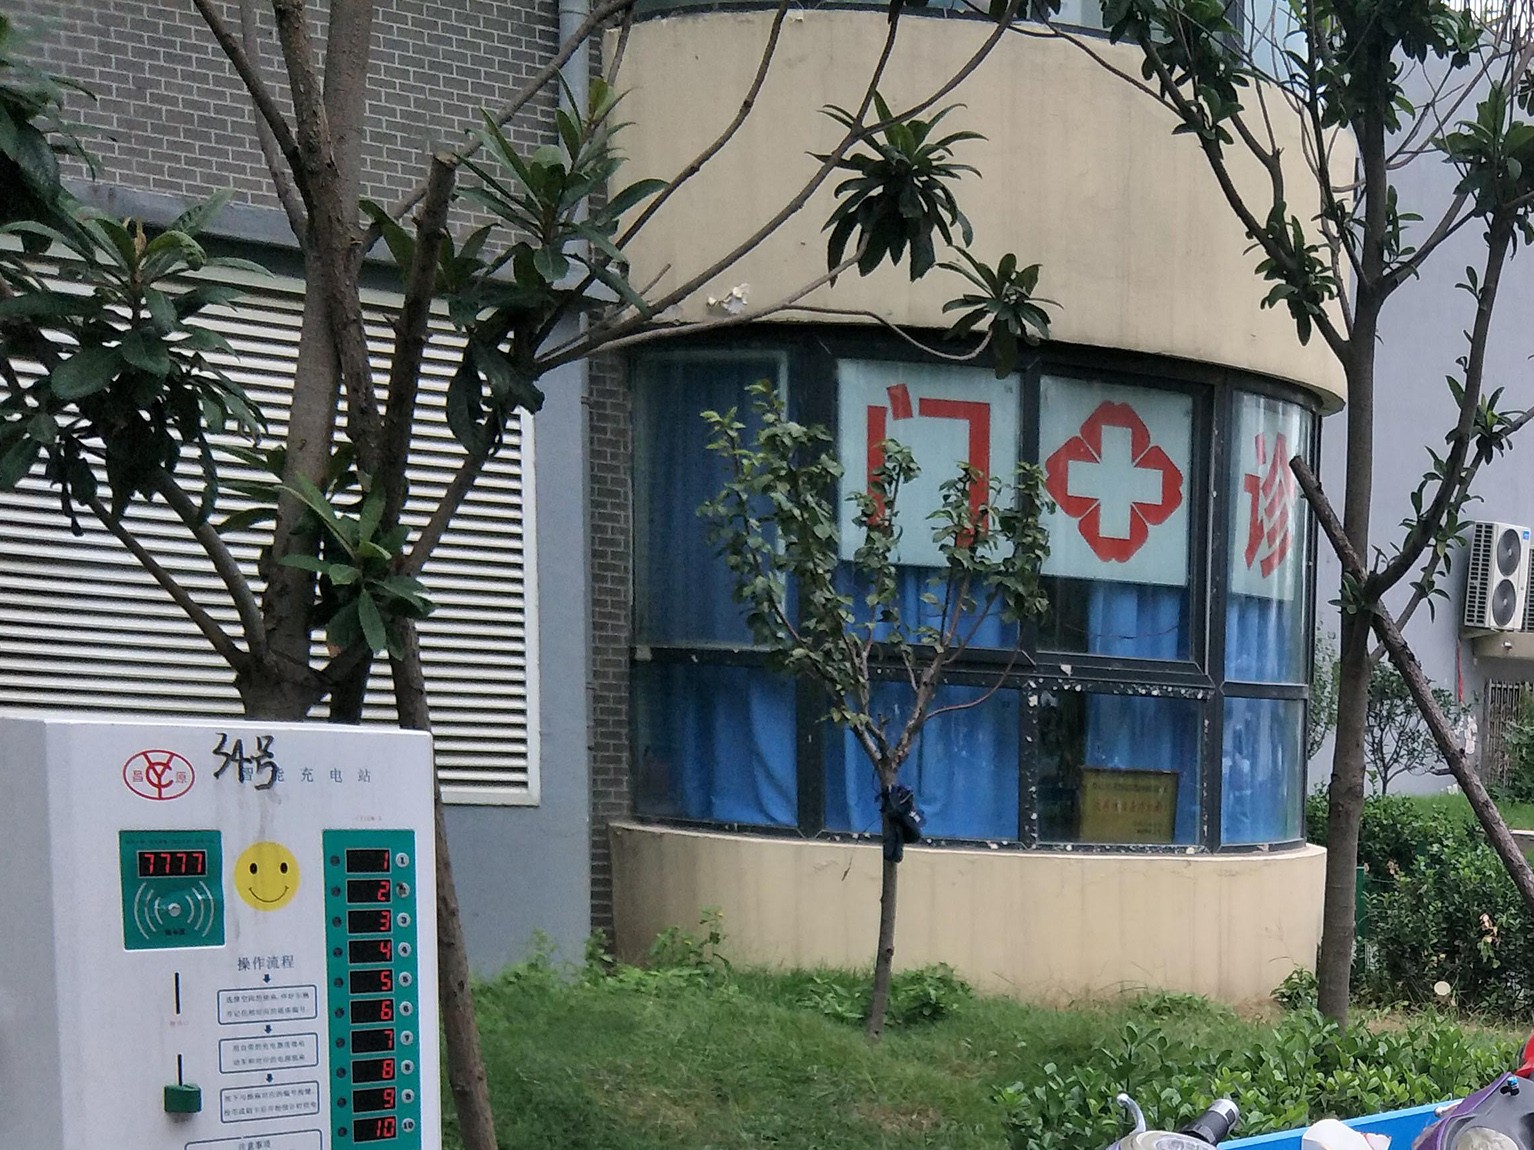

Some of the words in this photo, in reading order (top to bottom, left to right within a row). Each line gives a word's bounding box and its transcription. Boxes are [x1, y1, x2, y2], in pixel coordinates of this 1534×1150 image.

[866, 383, 990, 548] 门
[1244, 431, 1294, 579] 诊
[144, 853, 203, 874] 7777
[383, 851, 389, 870] 1
[377, 881, 389, 901] 2
[379, 911, 390, 931] 3
[379, 941, 391, 960] 4
[237, 954, 295, 972] 操作流程
[380, 971, 391, 991] 5
[380, 1000, 392, 1020] 6
[384, 1030, 393, 1049] 7
[382, 1059, 394, 1079] 8
[383, 1088, 395, 1109] 9
[376, 1118, 395, 1138] 10
